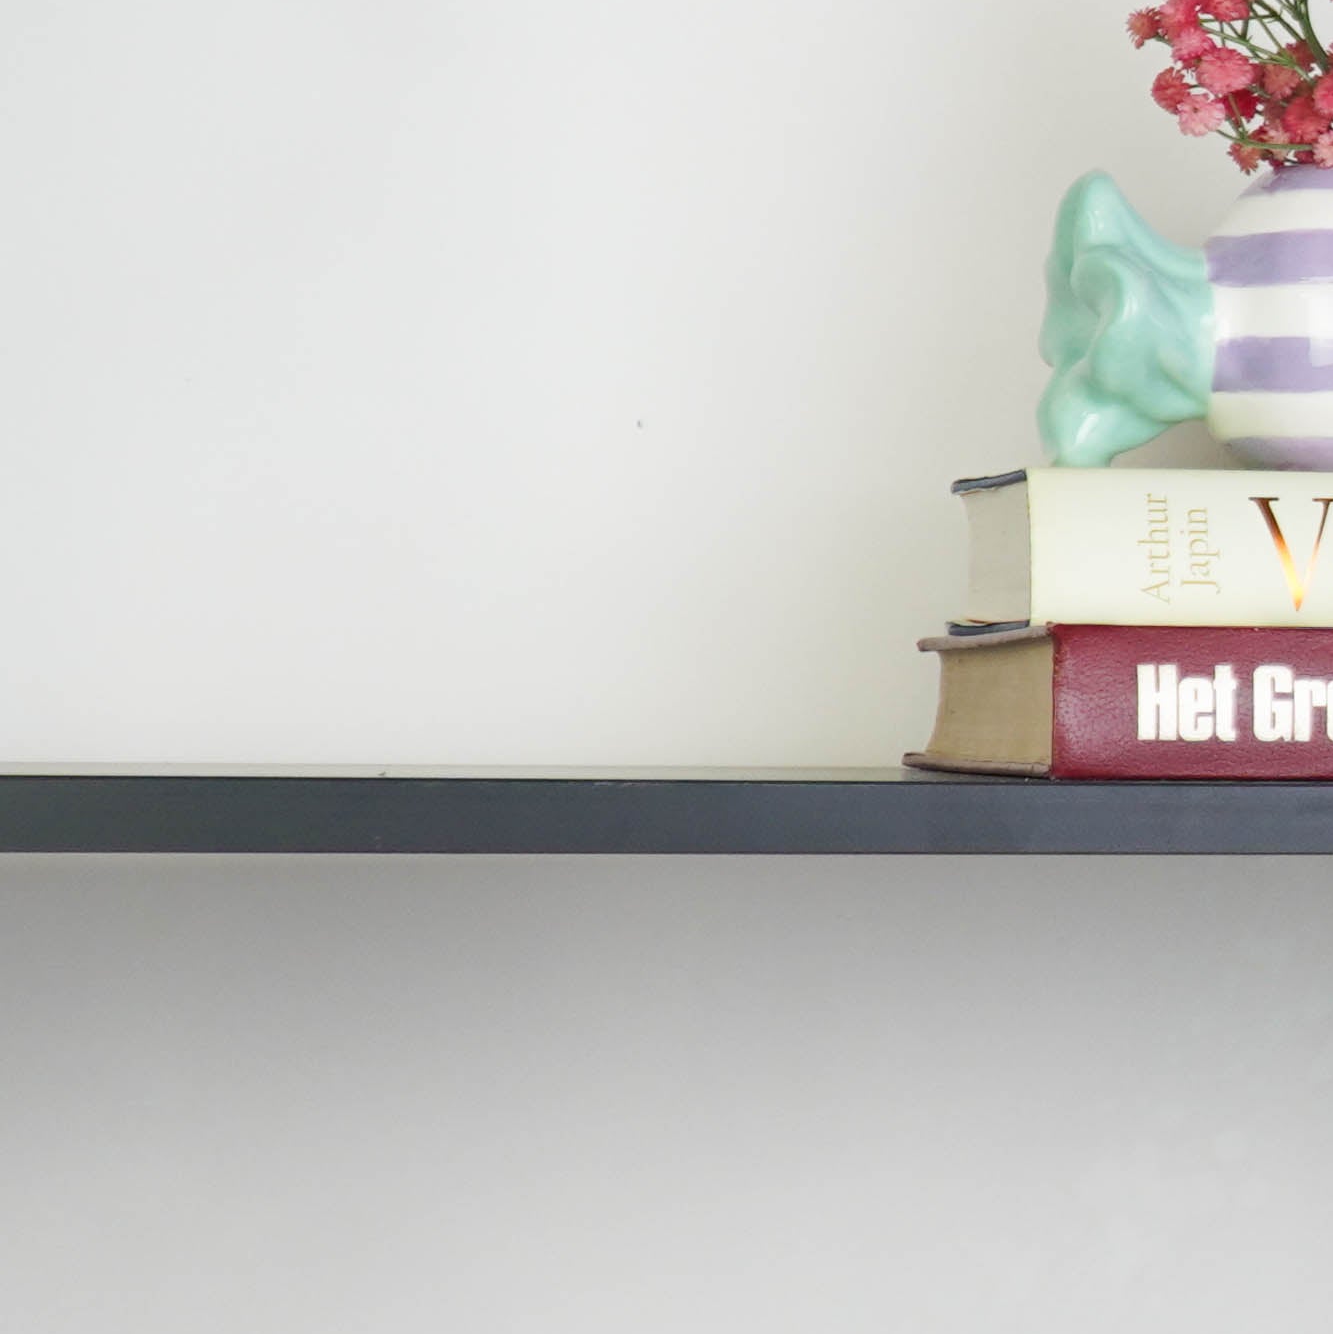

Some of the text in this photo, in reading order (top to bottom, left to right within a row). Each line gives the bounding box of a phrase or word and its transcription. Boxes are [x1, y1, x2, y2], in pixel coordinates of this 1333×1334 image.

[1136, 493, 1171, 604] Arthur
[1180, 507, 1221, 594] Japin
[1136, 663, 1236, 742] Het
